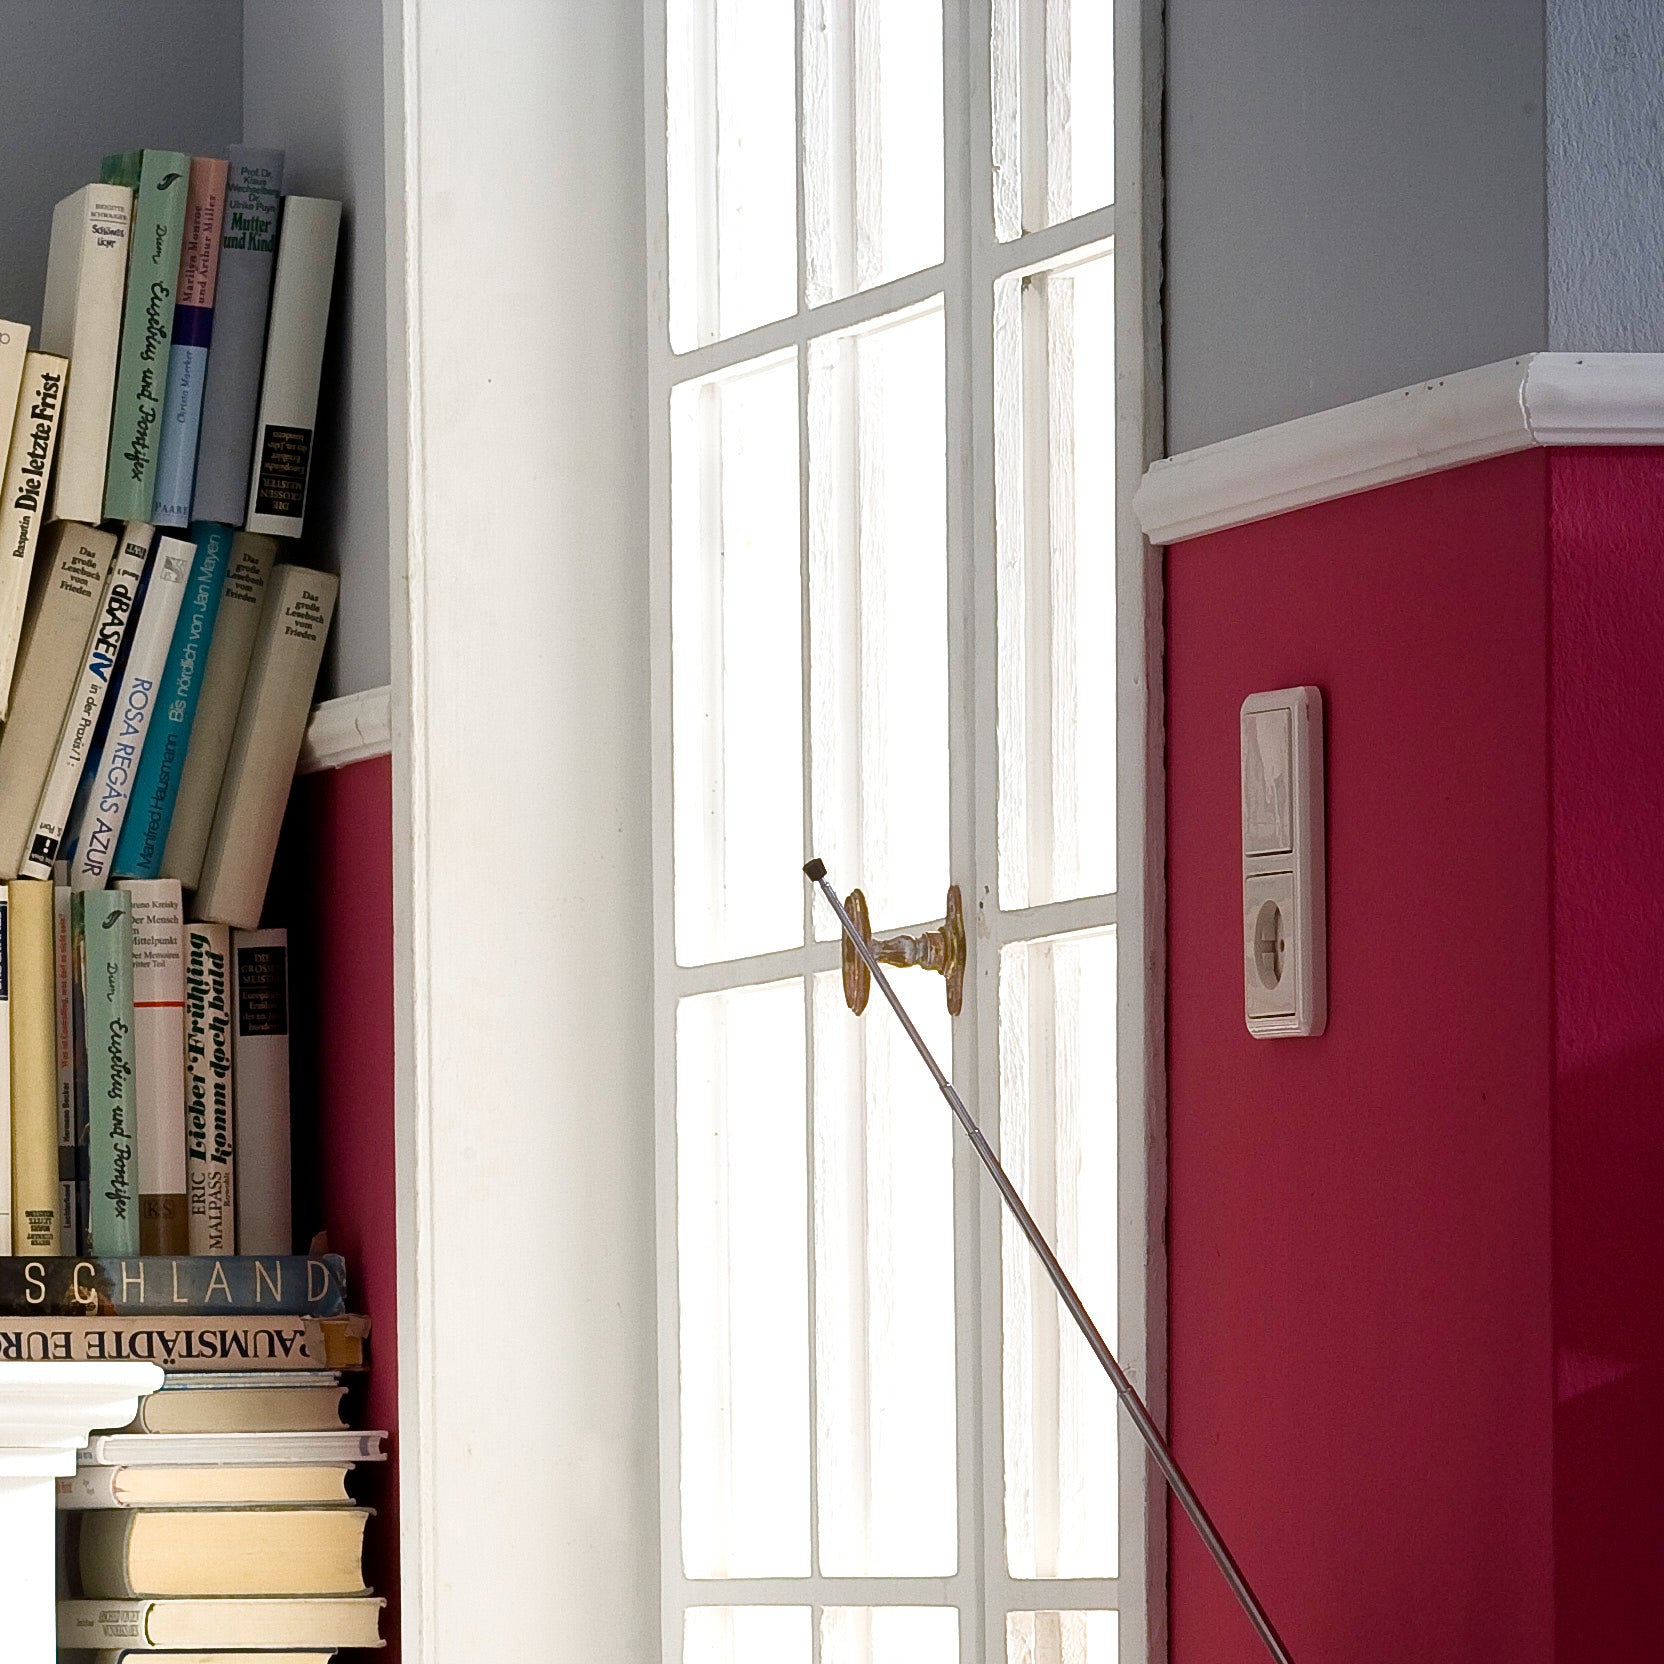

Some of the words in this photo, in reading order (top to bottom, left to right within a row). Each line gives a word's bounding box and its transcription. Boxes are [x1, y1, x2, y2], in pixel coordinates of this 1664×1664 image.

[143, 281, 169, 362] Eusebius
[31, 373, 61, 422] Frist
[142, 366, 157, 403] und
[22, 422, 52, 475] letzte
[125, 401, 157, 481] Pontifex
[14, 476, 40, 512] Die
[13, 515, 31, 558] Rasputin
[202, 534, 221, 586] Mayen
[196, 589, 210, 612] Jan
[285, 607, 323, 623] Lesebuch
[295, 600, 320, 612] große
[303, 591, 318, 602] Das
[187, 614, 203, 642] von
[285, 626, 316, 641] Frieden
[295, 618, 312, 629] vom
[174, 644, 197, 697] nördlich
[169, 700, 185, 722] Bis
[153, 734, 178, 811] Hausmann
[138, 806, 162, 869] Manfred
[188, 932, 210, 1058] Frühling
[209, 951, 225, 1012] bald
[210, 1012, 230, 1080] doch
[188, 1065, 207, 1163] Lieber
[210, 1082, 232, 1164] komm
[192, 1172, 206, 1215] ERIC
[210, 1171, 223, 1250] MALPASS
